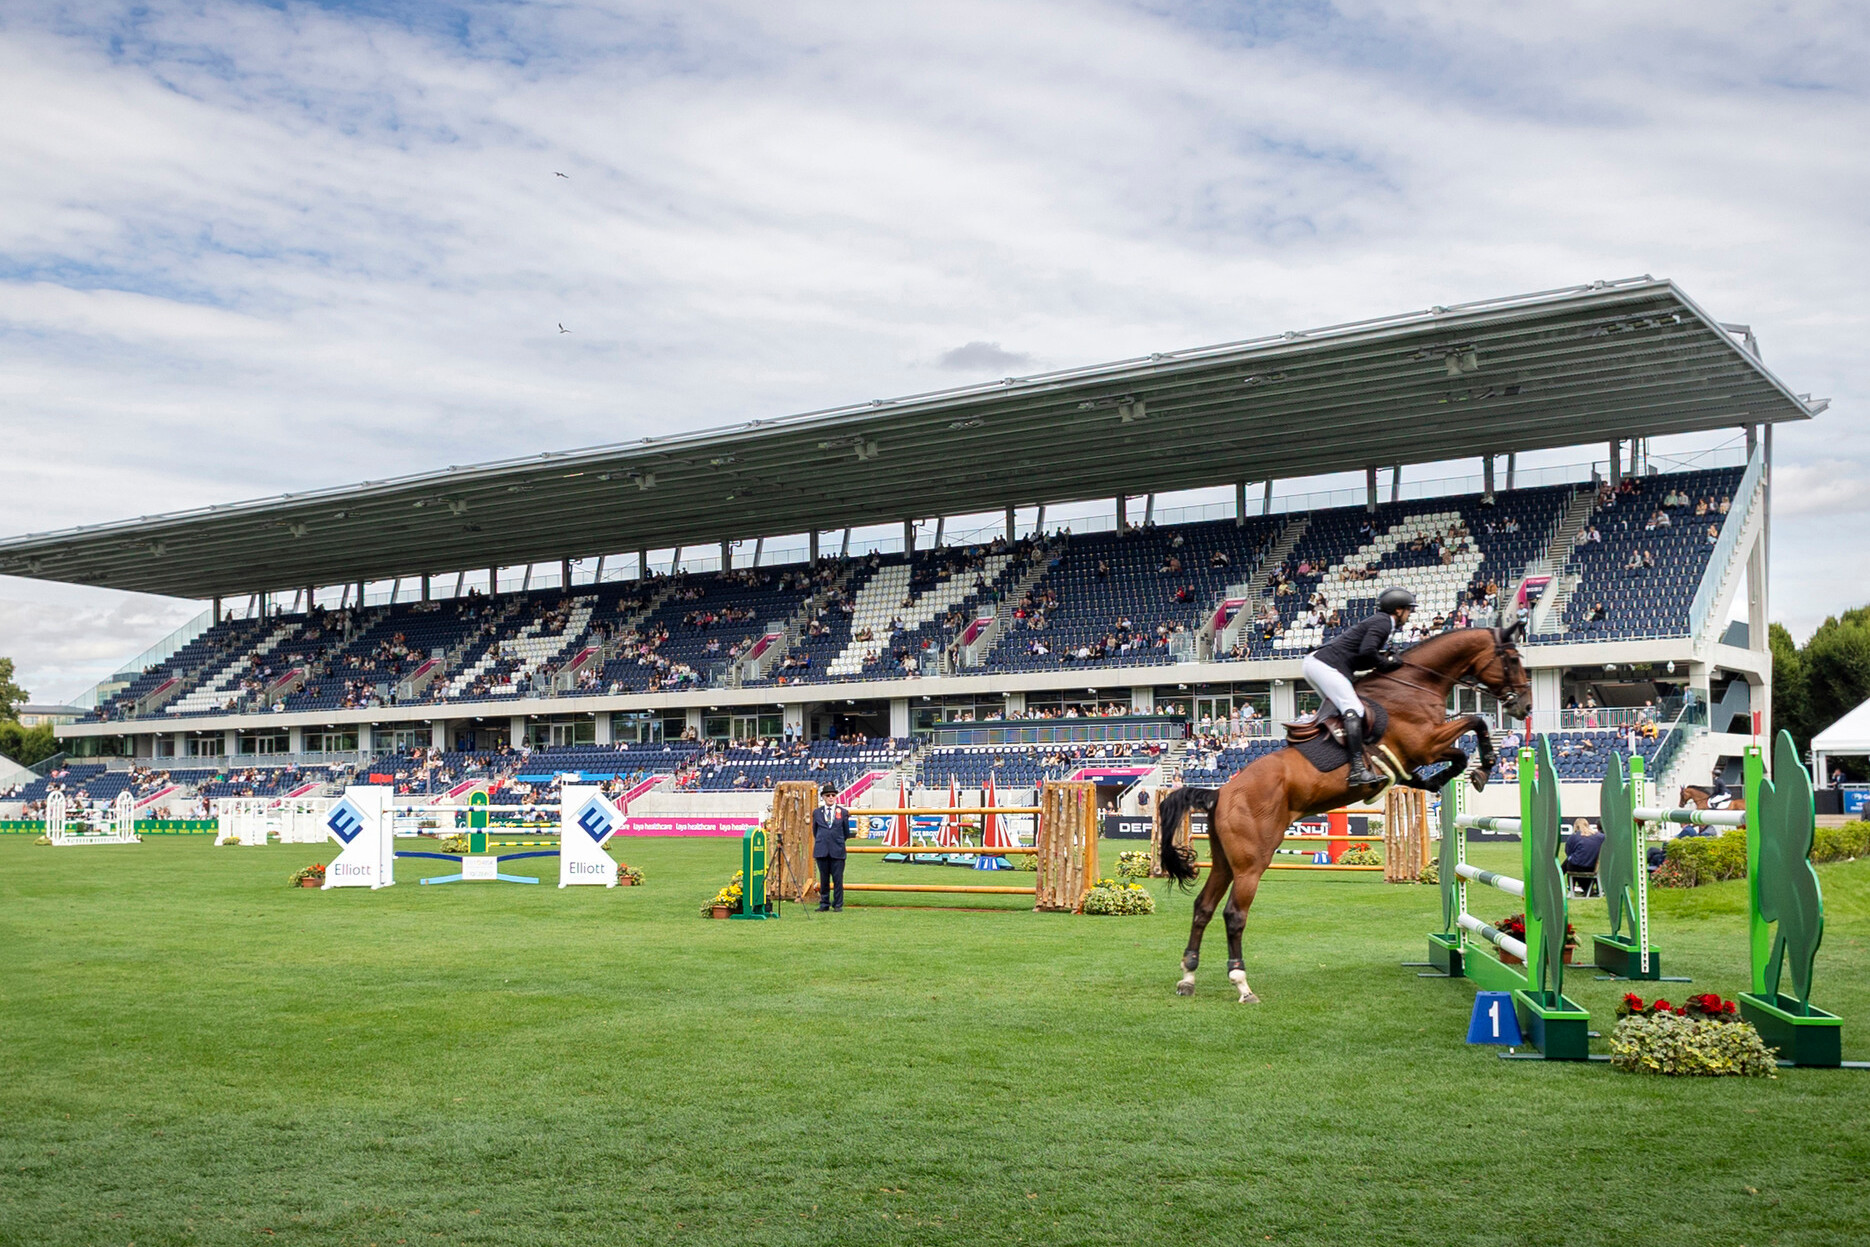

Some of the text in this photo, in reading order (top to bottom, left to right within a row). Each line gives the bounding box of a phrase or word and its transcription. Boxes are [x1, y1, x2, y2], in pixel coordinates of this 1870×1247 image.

[688, 823, 716, 831] healthcare
[335, 864, 372, 876] Elliott
[569, 862, 605, 874] Elliott
[1488, 1000, 1500, 1037] 1
